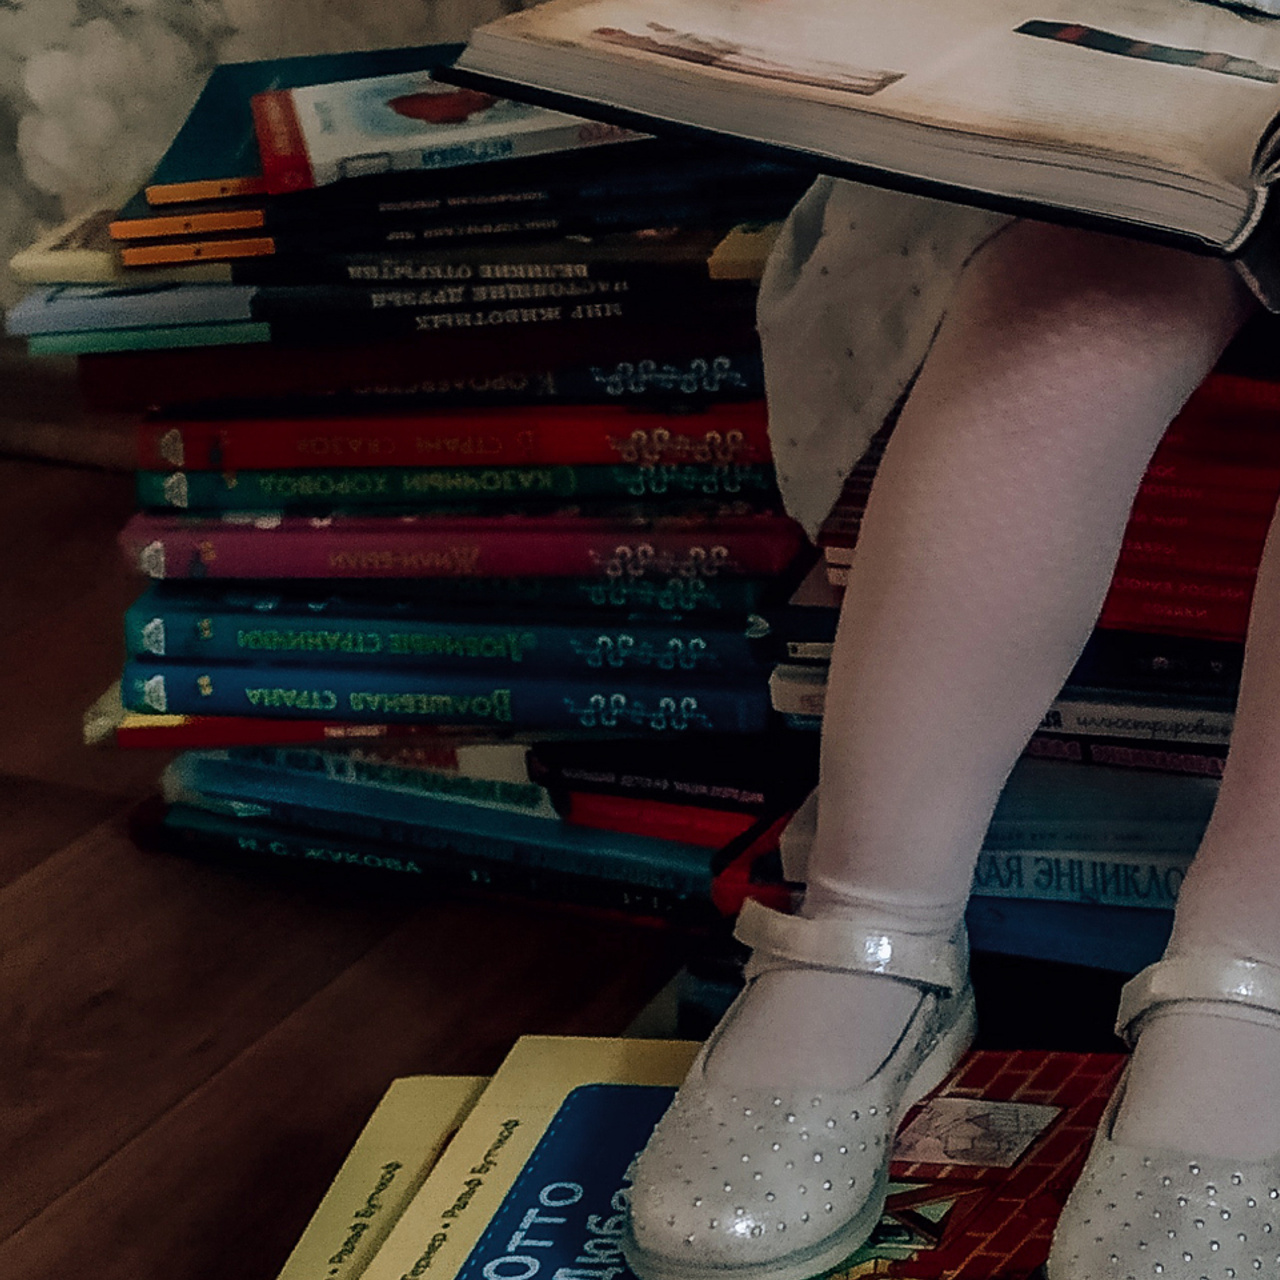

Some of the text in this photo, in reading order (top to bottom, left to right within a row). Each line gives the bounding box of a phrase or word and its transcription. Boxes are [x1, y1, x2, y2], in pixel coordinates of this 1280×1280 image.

[480, 263, 589, 280] ВЕЛИКИЕ
[414, 302, 623, 330] МИР ЖИВОТНЫХ
[245, 686, 339, 713] СТРАНА
[303, 847, 424, 875] ЖУКОВА
